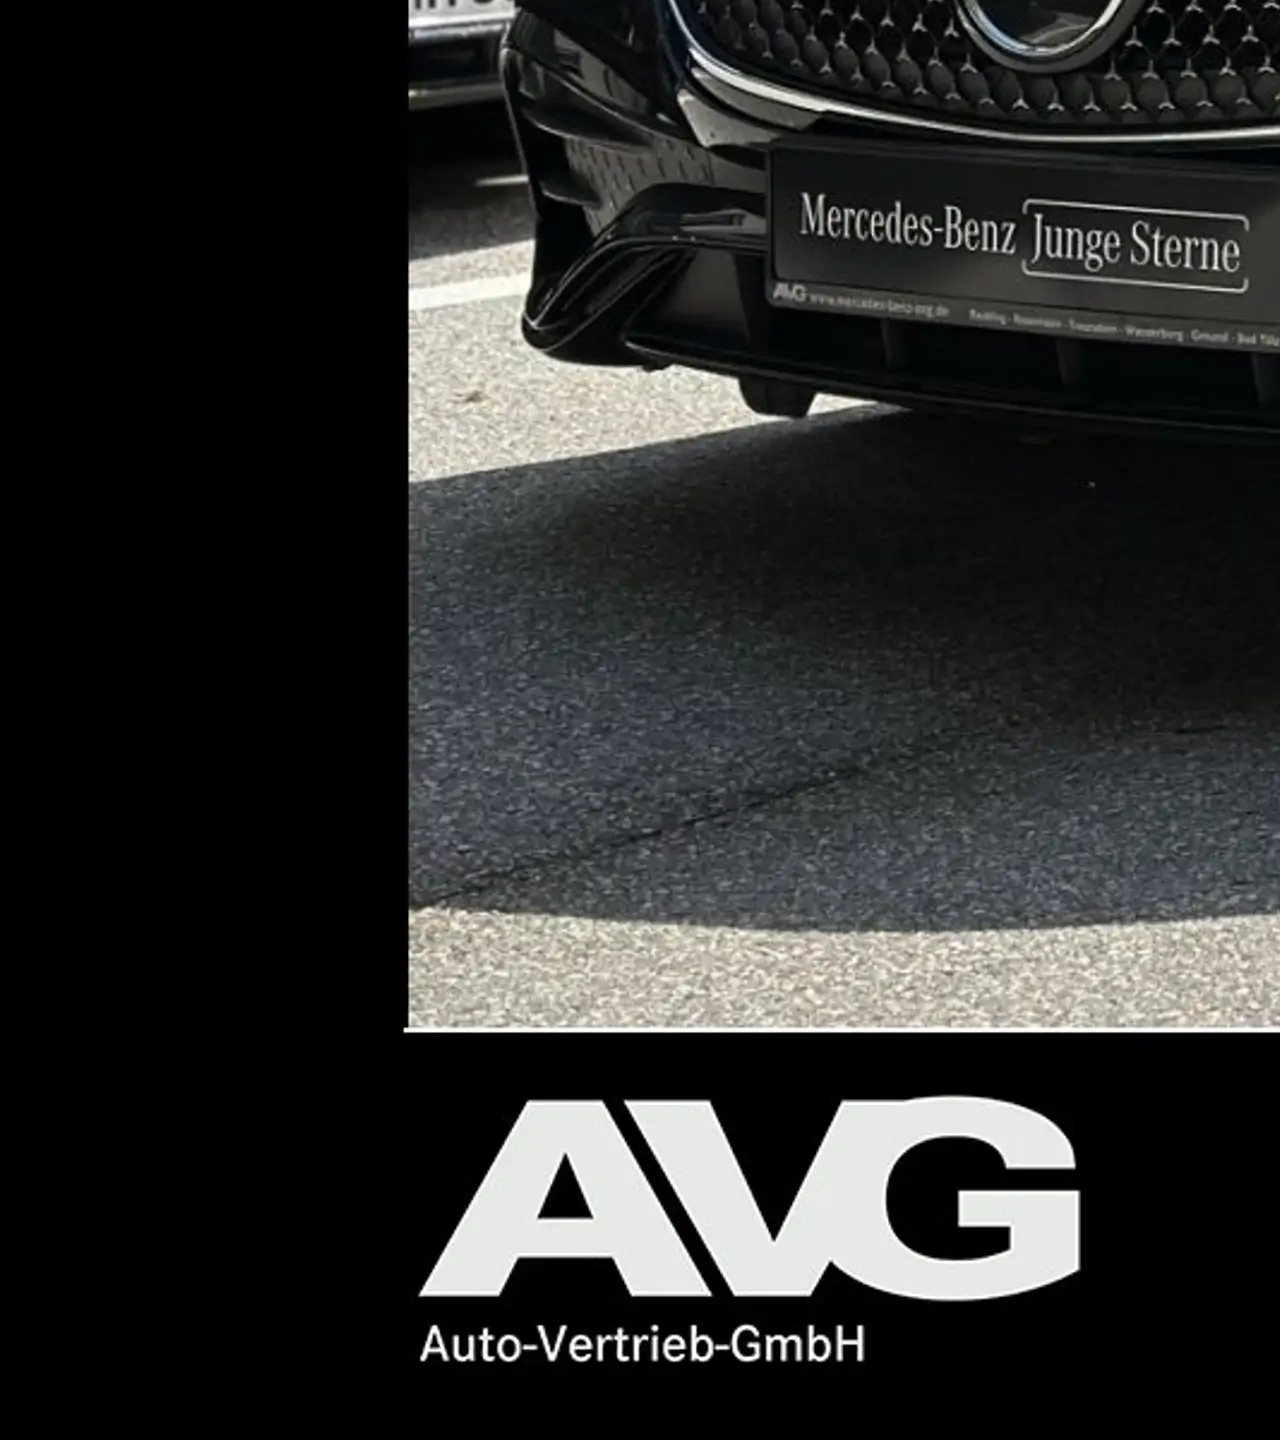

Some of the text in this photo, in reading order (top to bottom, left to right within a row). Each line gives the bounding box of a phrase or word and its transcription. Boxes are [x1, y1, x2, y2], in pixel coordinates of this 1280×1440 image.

[800, 192, 1240, 273] Mercedes-Benz Junge Sterne
